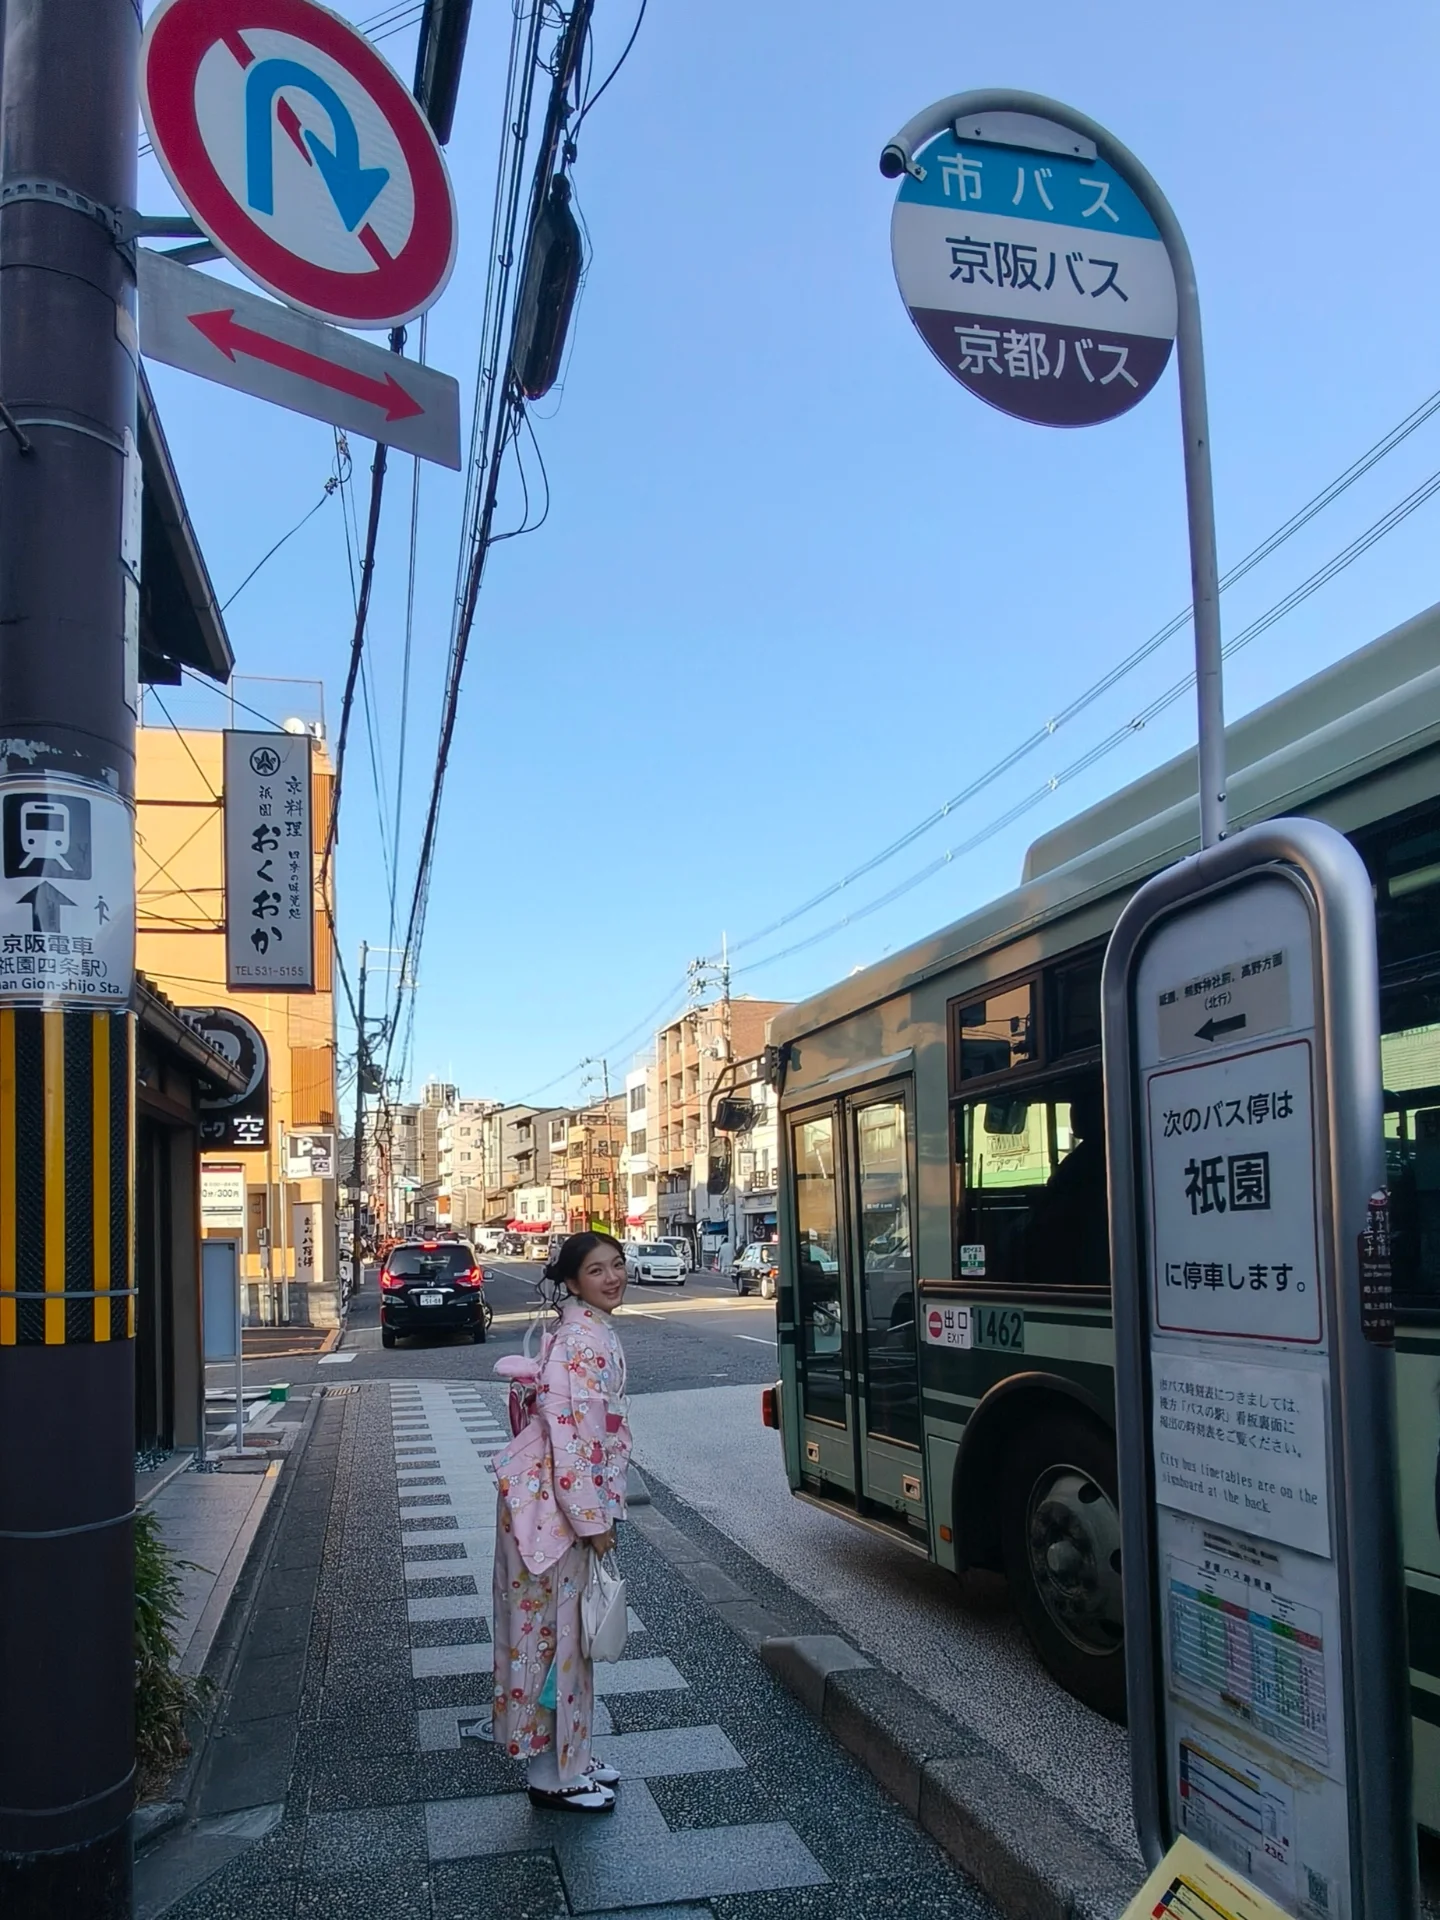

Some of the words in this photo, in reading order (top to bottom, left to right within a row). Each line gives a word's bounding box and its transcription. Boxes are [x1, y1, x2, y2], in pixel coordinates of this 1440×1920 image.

[937, 152, 1120, 223] 市バス
[945, 236, 1129, 302] 京阪バス
[954, 324, 1140, 388] 京都バス
[284, 776, 303, 838] 京料理
[250, 823, 282, 955] おくおか
[2, 934, 94, 956] 京阪電車
[22, 977, 96, 994] Gion-shijo
[100, 981, 123, 995] Sta.
[235, 966, 253, 976] TEL
[254, 966, 304, 977] 531-5155
[1162, 1090, 1293, 1138] 次のバス停は
[233, 1115, 265, 1145] 空
[202, 1189, 240, 1199] 0分/300円
[1184, 1151, 1271, 1216] 祇園
[1165, 1262, 1306, 1293] に停車します。
[944, 1310, 968, 1330] 出口
[978, 1310, 1022, 1348] 1462
[947, 1332, 965, 1345] EXIT
[1223, 1489, 1240, 1505] the
[1258, 1480, 1276, 1495] are
[1280, 1486, 1293, 1500] on
[1299, 1488, 1319, 1506] the
